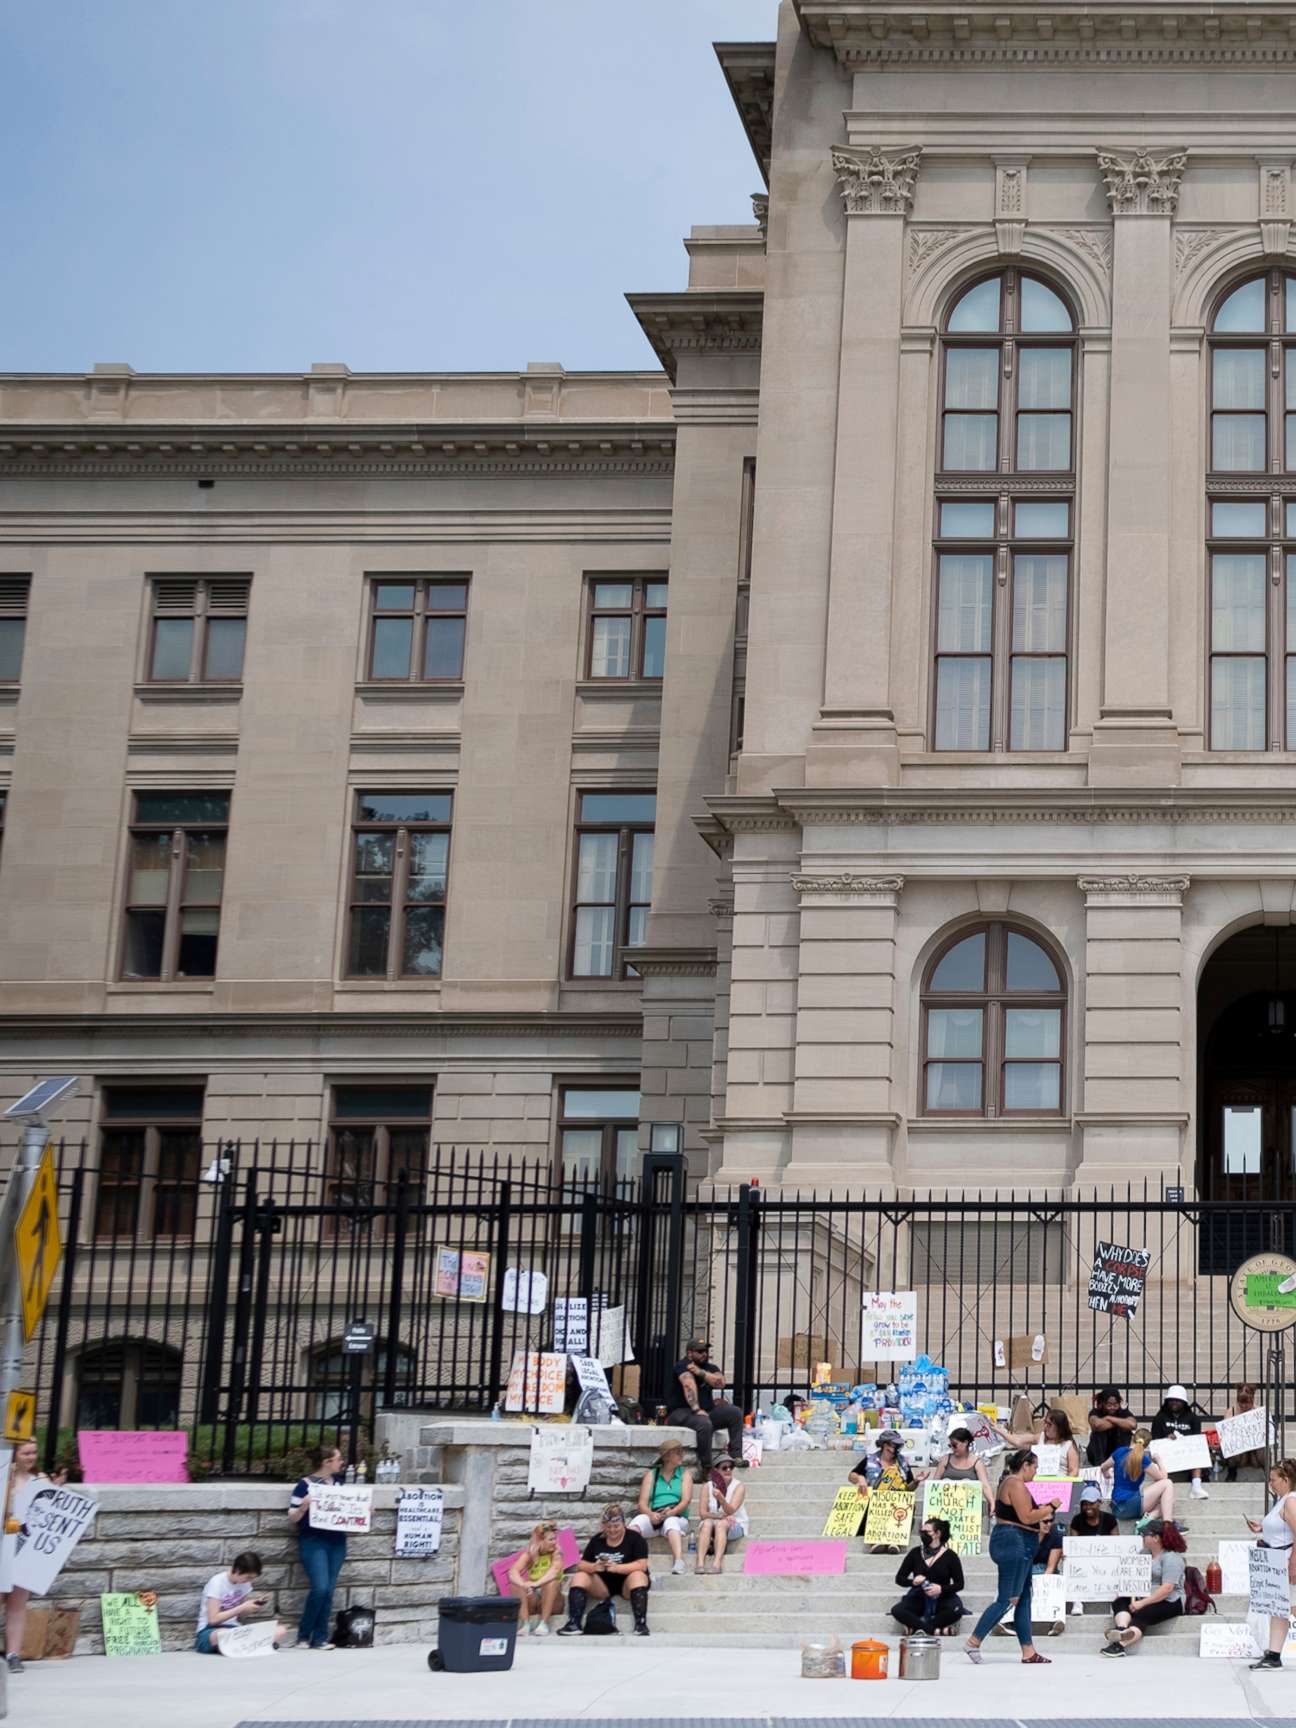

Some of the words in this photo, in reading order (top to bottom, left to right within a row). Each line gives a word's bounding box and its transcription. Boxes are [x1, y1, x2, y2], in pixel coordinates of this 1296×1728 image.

[1100, 1243, 1125, 1262] WHY
[1123, 1249, 1149, 1268] DOES
[1094, 1258, 1102, 1268] A
[1103, 1260, 1146, 1278] CORPSE
[1092, 1269, 1116, 1284] HAVE
[1117, 1275, 1143, 1292] MORE
[872, 1296, 887, 1312] May
[889, 1298, 902, 1309] the
[873, 1321, 890, 1329] grow
[872, 1491, 914, 1505] MISOGYNY
[929, 1495, 975, 1509] CHURCH
[51, 1490, 97, 1520] RUTH
[832, 1502, 866, 1512] ABORTION
[833, 1512, 855, 1523] SAFE
[939, 1507, 965, 1517] NOT
[38, 1512, 84, 1539] SENT
[948, 1515, 977, 1524] STATE
[865, 1529, 909, 1540] ABORTION
[952, 1524, 980, 1534] MUST
[33, 1532, 62, 1555] US
[959, 1534, 980, 1542] OUR
[957, 1541, 982, 1556] FATE
[1119, 1555, 1151, 1566] WOMEN
[1119, 1567, 1134, 1577] ARE
[1136, 1567, 1150, 1577] NOT
